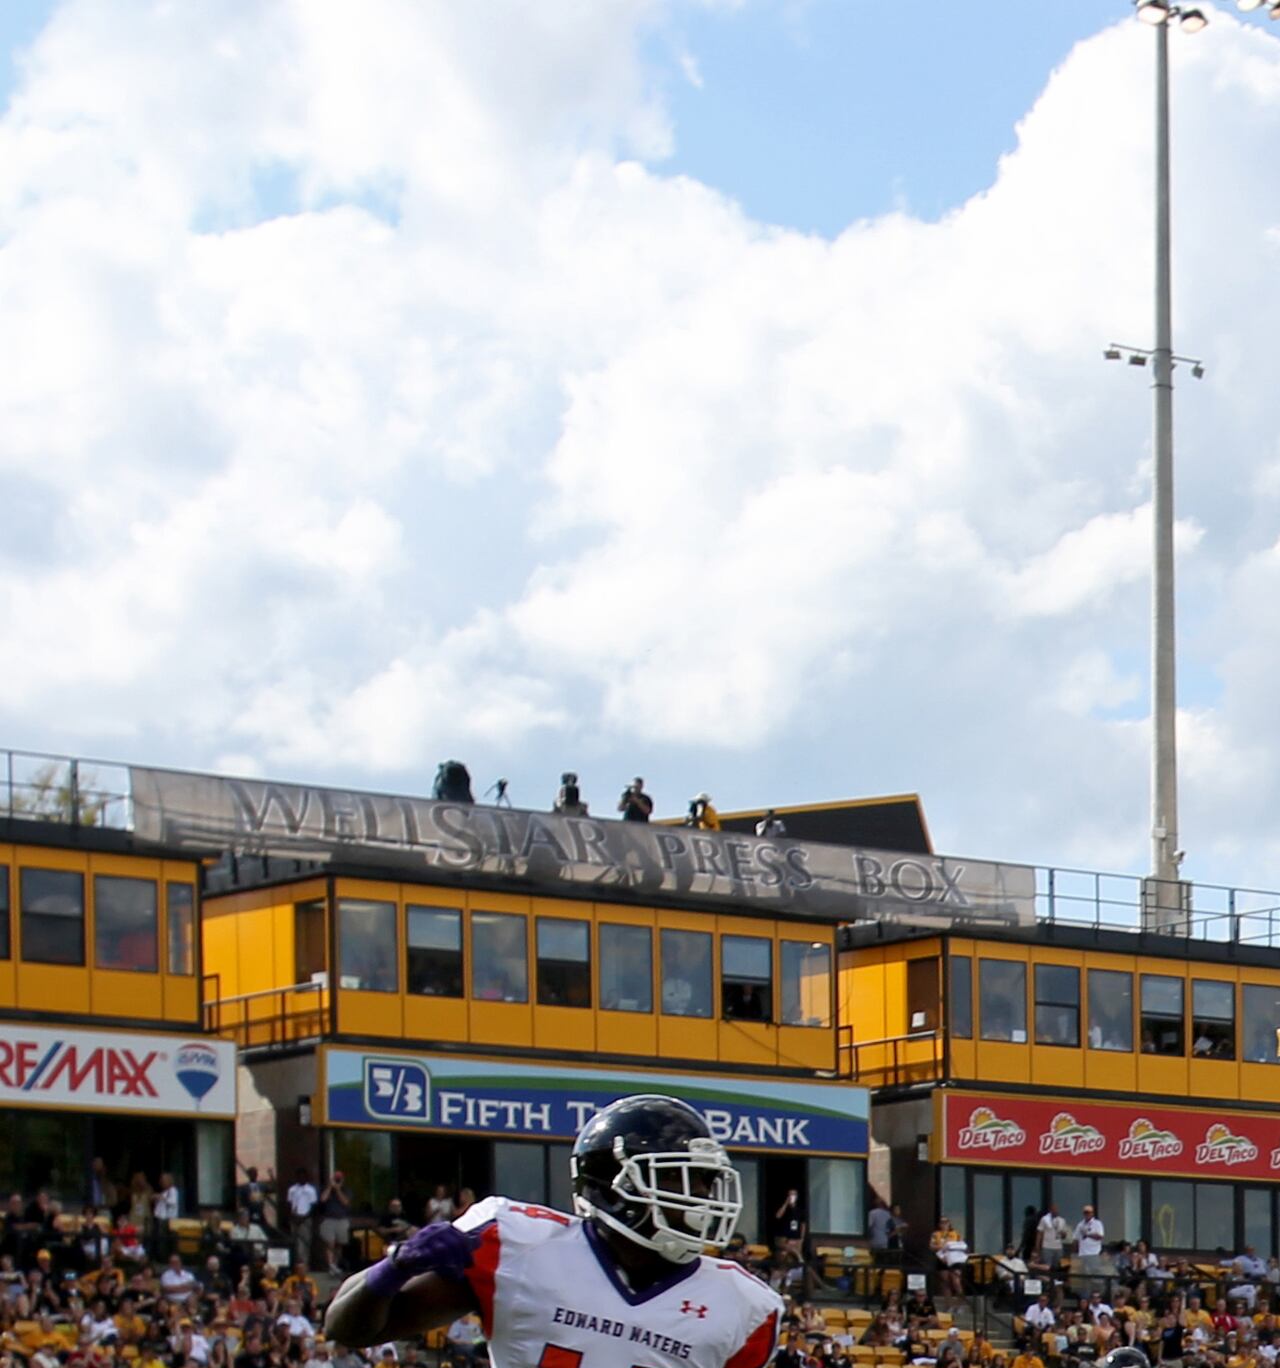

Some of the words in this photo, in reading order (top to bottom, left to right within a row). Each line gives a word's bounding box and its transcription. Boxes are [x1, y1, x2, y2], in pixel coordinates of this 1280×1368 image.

[224, 780, 612, 869] WELLSTAR
[655, 832, 814, 890] PRESS
[852, 852, 970, 906] BOX
[0, 1039, 159, 1098] RE/MAX
[438, 1091, 552, 1131] FIFTH
[703, 1108, 811, 1146] BANK
[552, 1306, 625, 1338] EDWARD
[629, 1326, 693, 1360] WATERS
